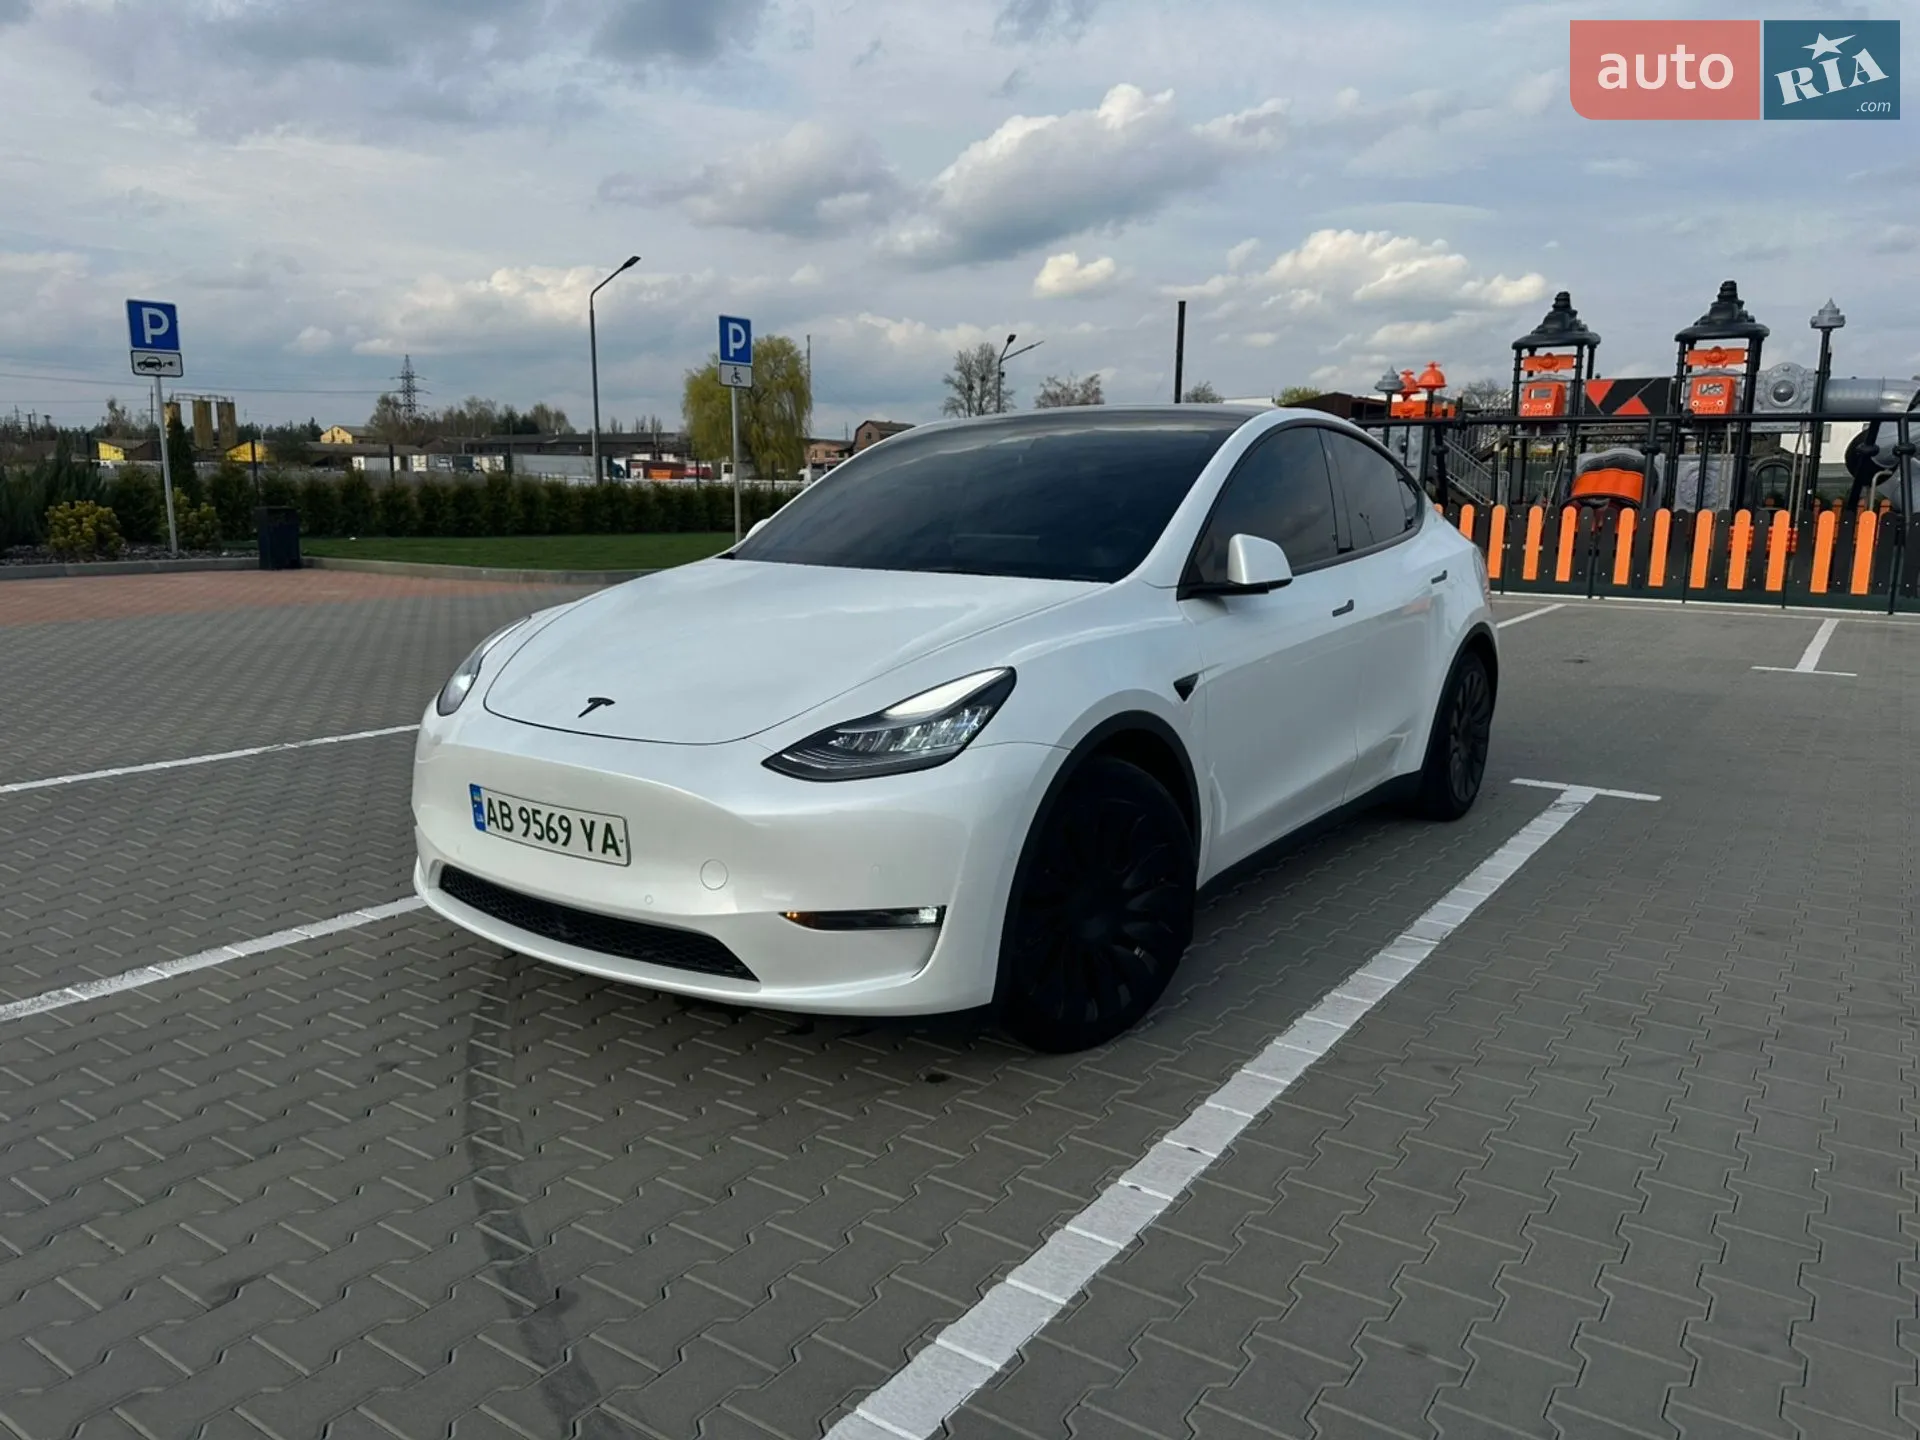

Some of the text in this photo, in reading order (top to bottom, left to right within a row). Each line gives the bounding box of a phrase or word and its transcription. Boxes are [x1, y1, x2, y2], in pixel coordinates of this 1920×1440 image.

[141, 306, 170, 345] P
[727, 321, 747, 358] P
[486, 797, 622, 857] AB 9569 YA
